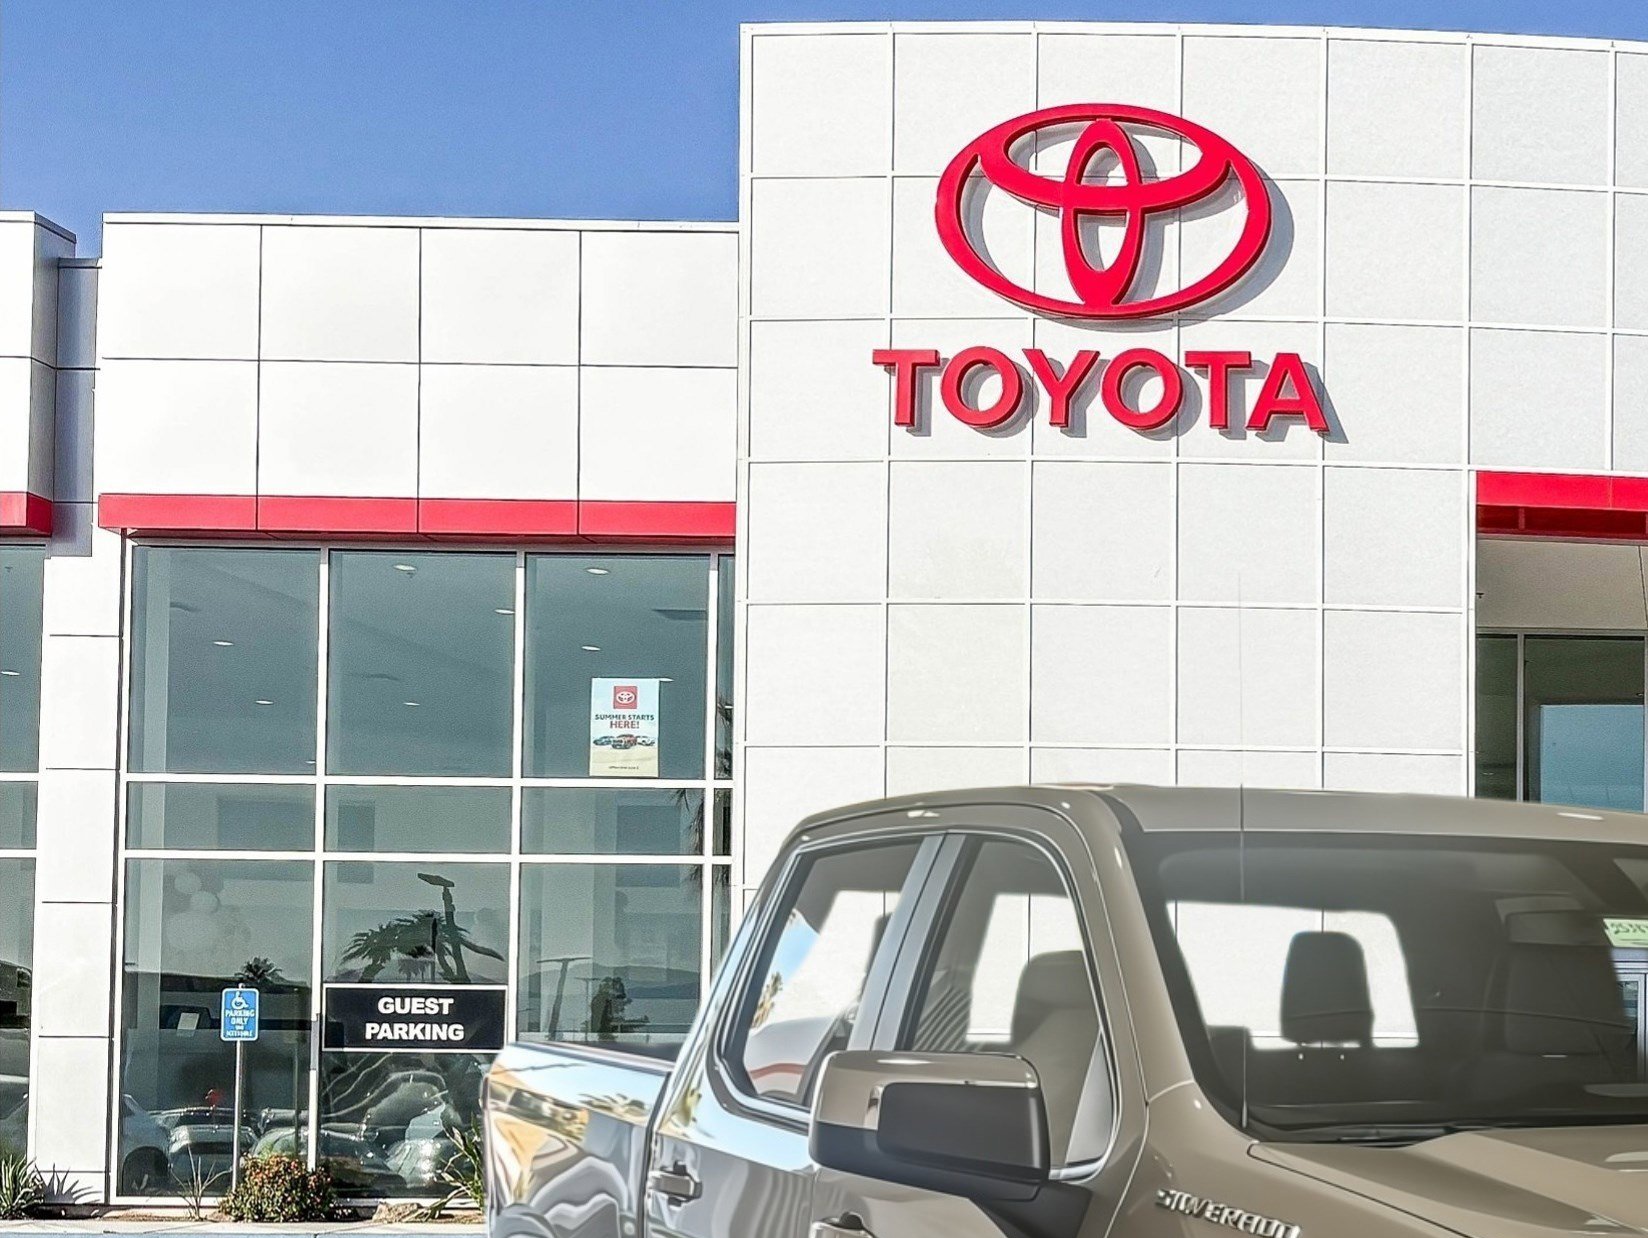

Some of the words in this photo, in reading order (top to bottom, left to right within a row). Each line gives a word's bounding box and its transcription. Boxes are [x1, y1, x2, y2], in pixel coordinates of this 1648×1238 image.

[872, 346, 1329, 432] TOYOTA
[610, 720, 640, 729] HERE!
[377, 996, 454, 1015] GUEST
[365, 1022, 465, 1041] PARKING
